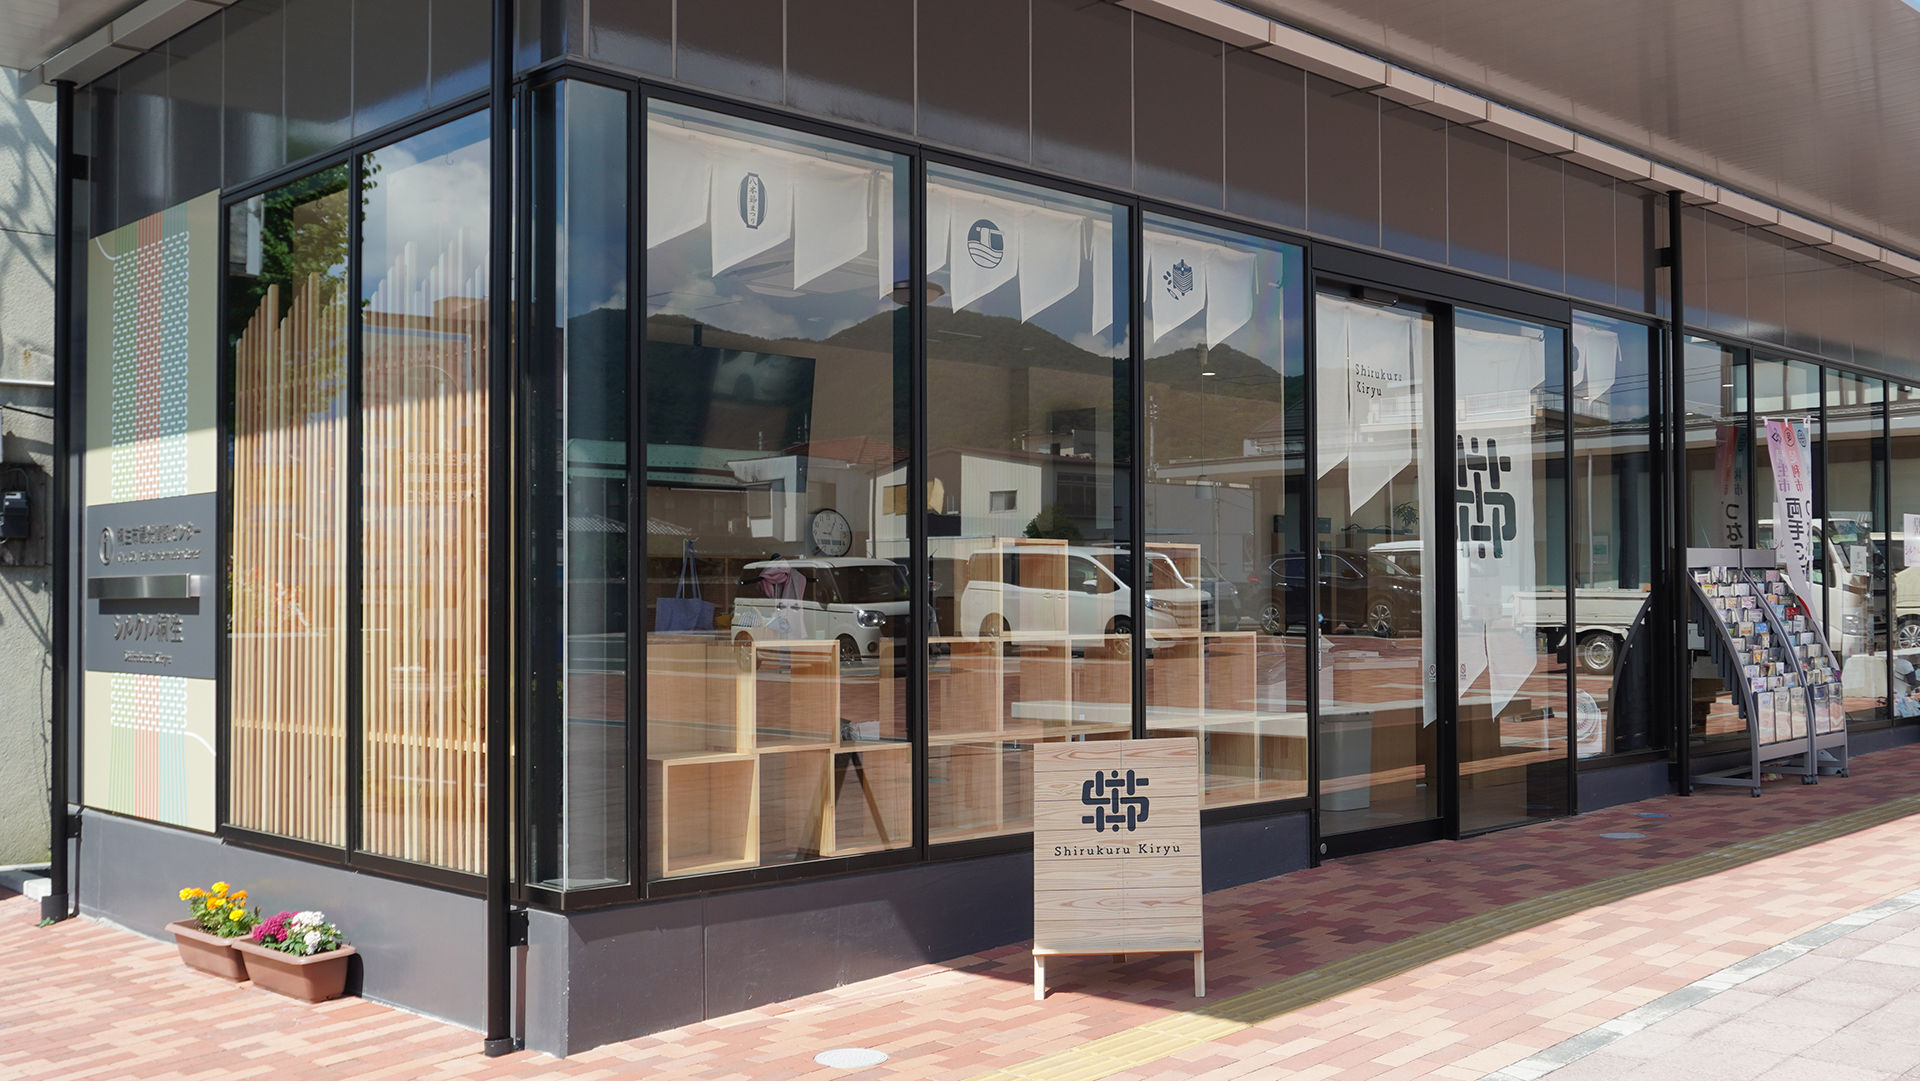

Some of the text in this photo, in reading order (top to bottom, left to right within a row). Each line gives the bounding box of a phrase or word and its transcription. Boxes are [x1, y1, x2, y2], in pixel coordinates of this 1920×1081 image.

[1356, 380, 1382, 399] Kiryu
[1054, 843, 1181, 857] Shirukuru Kiryu
